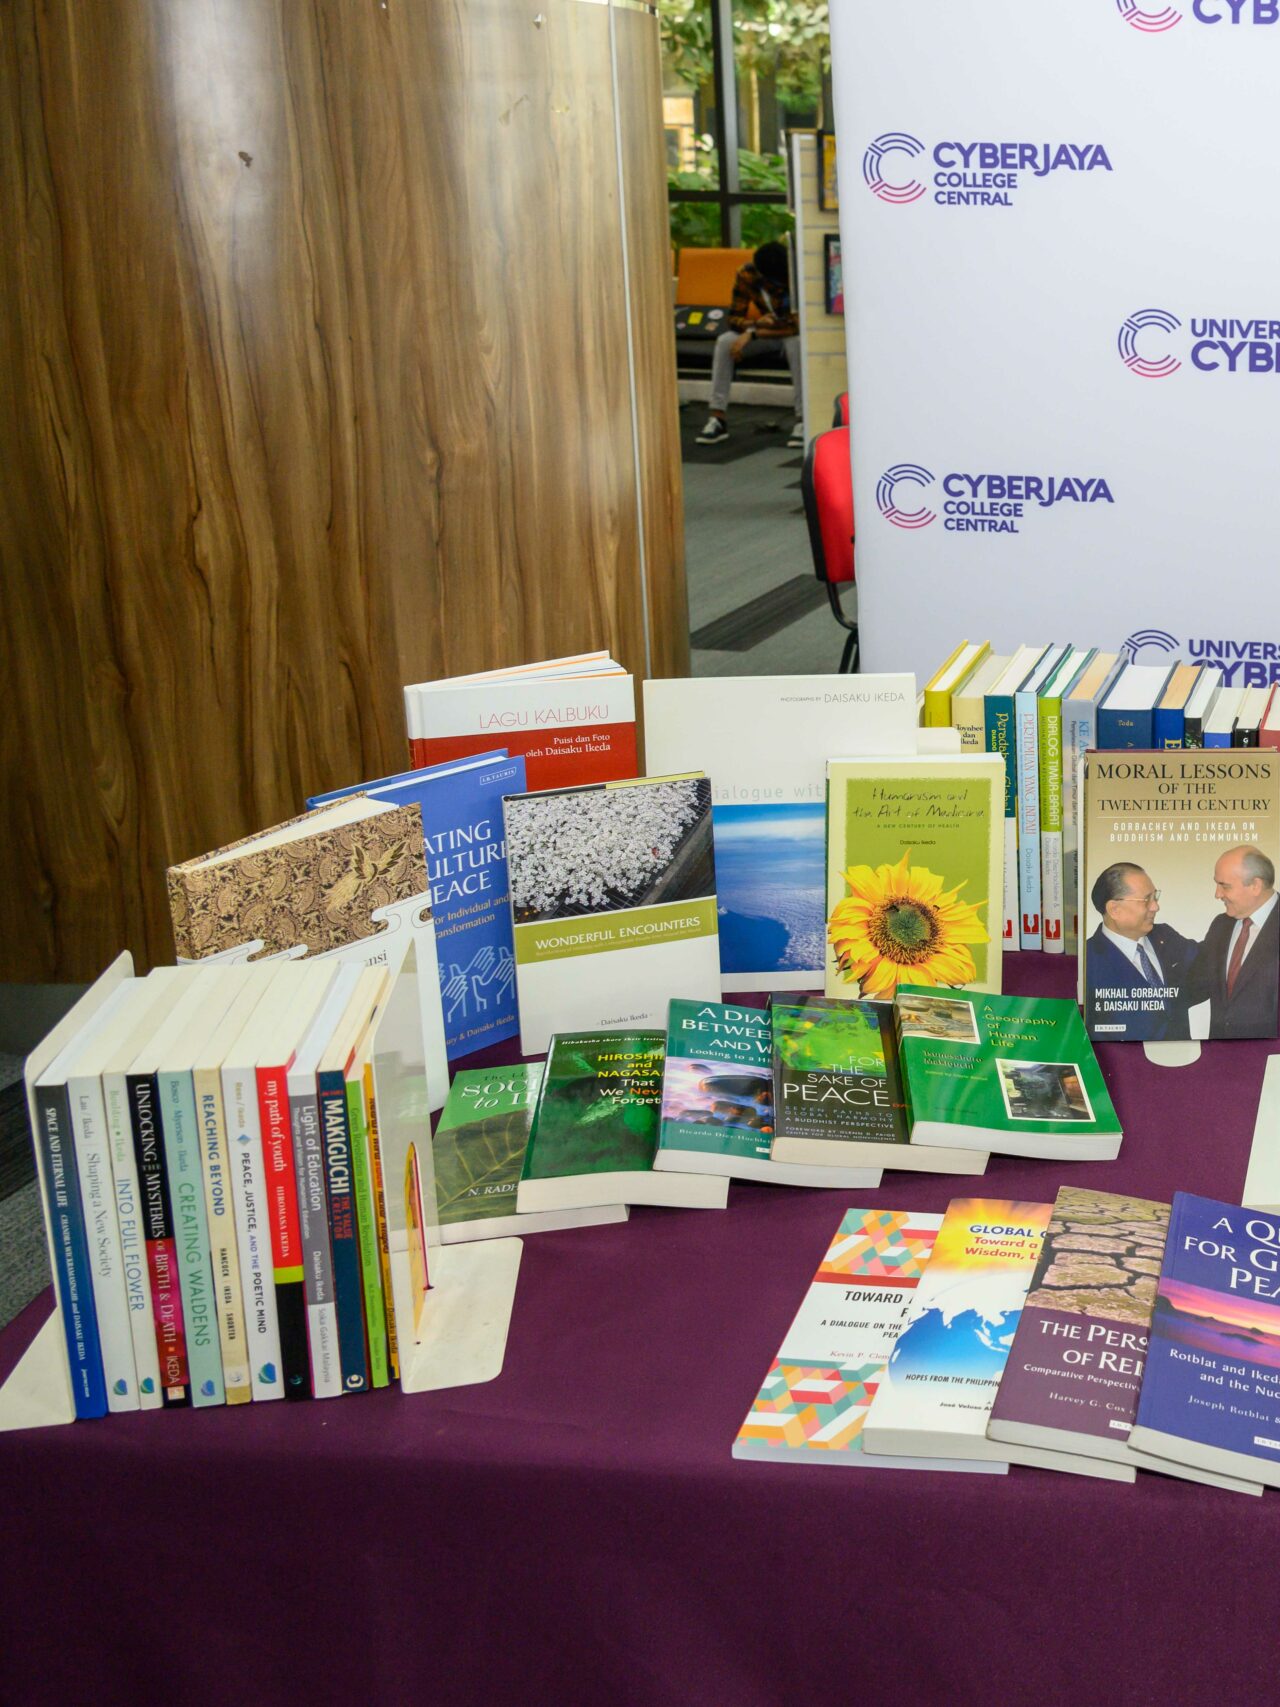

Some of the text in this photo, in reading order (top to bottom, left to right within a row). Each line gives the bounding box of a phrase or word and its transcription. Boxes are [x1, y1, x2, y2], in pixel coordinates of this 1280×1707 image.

[933, 142, 1113, 177] CYBERJAYA
[934, 172, 1017, 188] COLLEGE
[934, 191, 1013, 206] CENTRAL
[942, 473, 1115, 507] CYBERJAYA
[943, 501, 1023, 517] COLLEGE
[943, 518, 1019, 534] CENTRAL
[824, 693, 871, 703] DAISAKU
[480, 704, 609, 729] LAGU KALBUKU
[1047, 715, 1058, 757] DIALOG
[545, 743, 611, 756] Daisaku Ikeda
[1096, 763, 1271, 780] MORAL LESSONS
[1158, 782, 1217, 795] OF THE
[1097, 799, 1271, 811] TWENTIETH CENTURY
[1113, 822, 1236, 831] GORBACHEV AND IKEDA
[1110, 833, 1259, 842] BUDDHISM AND COMMUNISM
[535, 930, 615, 950] WONDERFUL
[619, 917, 701, 938] ENCOUNTERS
[1095, 987, 1180, 999] MIKHAIL GORBACHEV
[1103, 1000, 1165, 1011] DAISAKU IKEDA
[697, 1007, 717, 1020] A
[985, 1013, 1057, 1027] Geography
[989, 1030, 1038, 1041] Human
[709, 1038, 750, 1052] AND
[991, 1039, 1015, 1048] Life
[689, 1048, 731, 1060] Looking
[849, 1055, 884, 1067] FOR
[830, 1063, 864, 1075] THE
[621, 1078, 655, 1087] That
[807, 1073, 887, 1088] SAKE OF
[600, 1088, 624, 1097] We
[783, 1082, 891, 1107] PEACE
[135, 1083, 158, 1169] UNLOCKING
[302, 1105, 316, 1137] Light
[841, 1121, 895, 1129] PERSPECTIVE
[324, 1099, 350, 1195] MAKIGUCHI
[202, 1094, 225, 1217] REACHING BEYOND
[308, 1153, 322, 1212] Education
[241, 1152, 265, 1307] PEACE, JUSTICE, POETIC
[969, 1224, 1035, 1238] GLOBAL
[1212, 1217, 1234, 1234] A
[974, 1236, 1026, 1248] Toward
[1184, 1235, 1237, 1263] FOR
[964, 1247, 1025, 1260] Wisdom,
[178, 1182, 211, 1347] CREATING WALDENS
[125, 1253, 145, 1311] FLOWER
[844, 1290, 904, 1304] TOWARD
[830, 1319, 870, 1329] DIALOGUE
[1040, 1320, 1082, 1340] THE
[1052, 1349, 1094, 1366] OF
[1169, 1348, 1217, 1369] Rotblat
[1222, 1363, 1246, 1377] and
[905, 1373, 949, 1384] HOPES FROM
[1023, 1363, 1084, 1380] Comparative
[1200, 1372, 1250, 1392] and the
[1049, 1391, 1126, 1413] Harvey Cox
[1188, 1394, 1269, 1422] Joseph Rotblat
